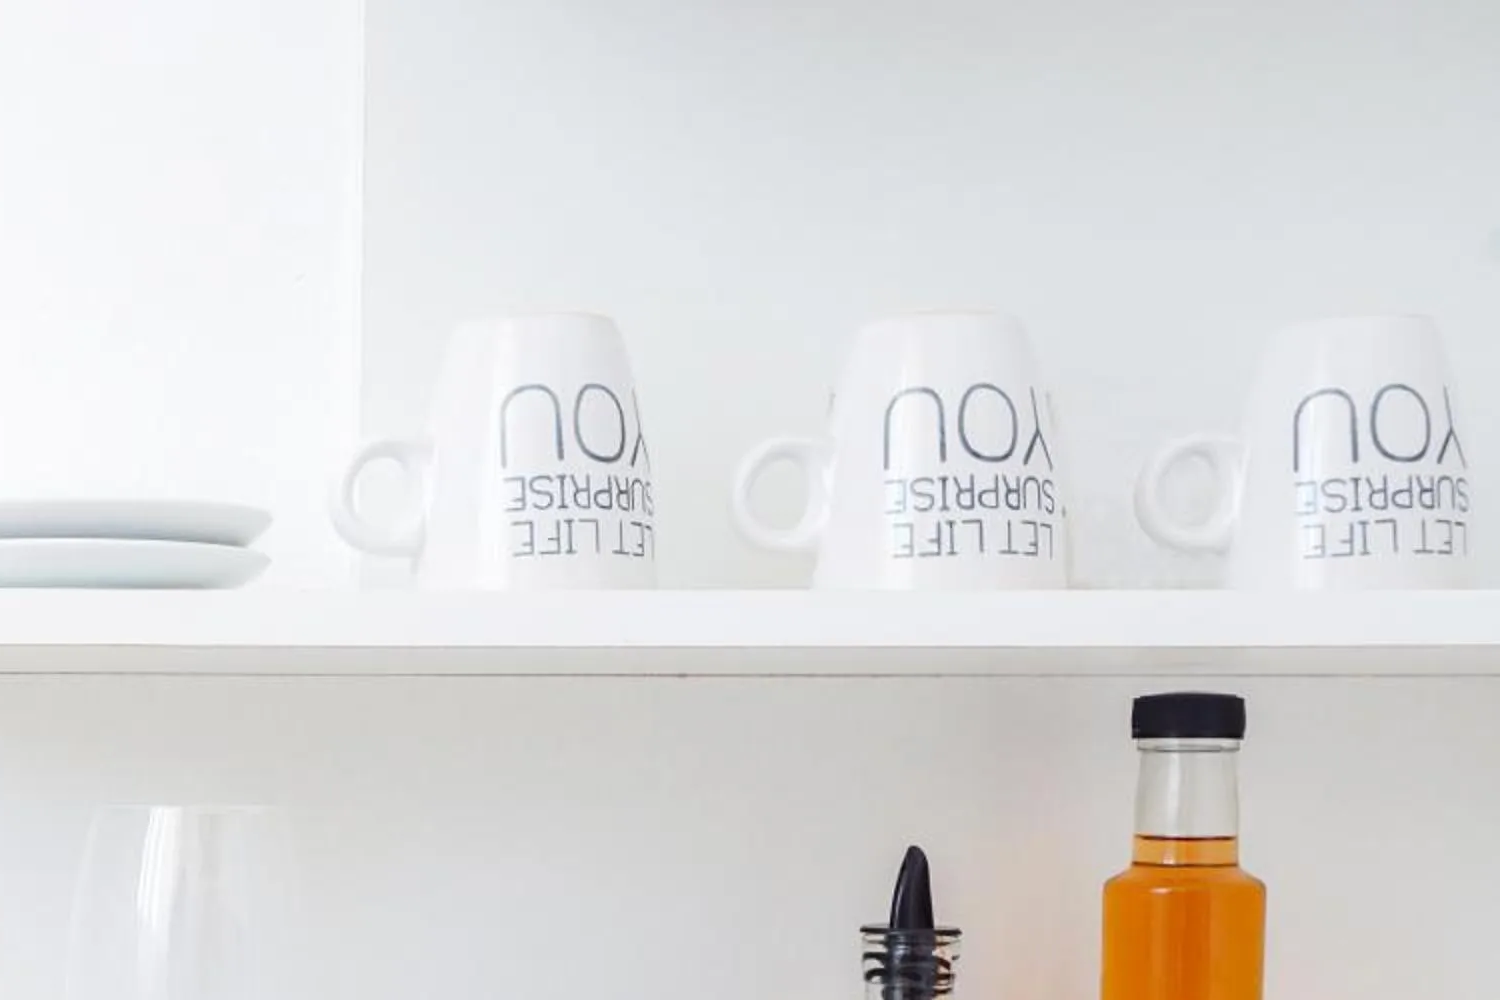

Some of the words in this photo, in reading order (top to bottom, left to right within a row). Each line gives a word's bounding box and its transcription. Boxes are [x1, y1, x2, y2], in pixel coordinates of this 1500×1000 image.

[499, 382, 652, 474] YOU
[883, 382, 1054, 472] YOU
[1292, 382, 1468, 473] YOU
[502, 473, 655, 517] SURPRISE
[883, 473, 1056, 516] SURPRISE
[1293, 473, 1470, 515] SURPRISE
[510, 517, 601, 557] LIFE
[891, 518, 986, 559] LIFE
[997, 518, 1053, 561] LET
[1302, 518, 1399, 560] LIFE
[1411, 518, 1468, 558] LET
